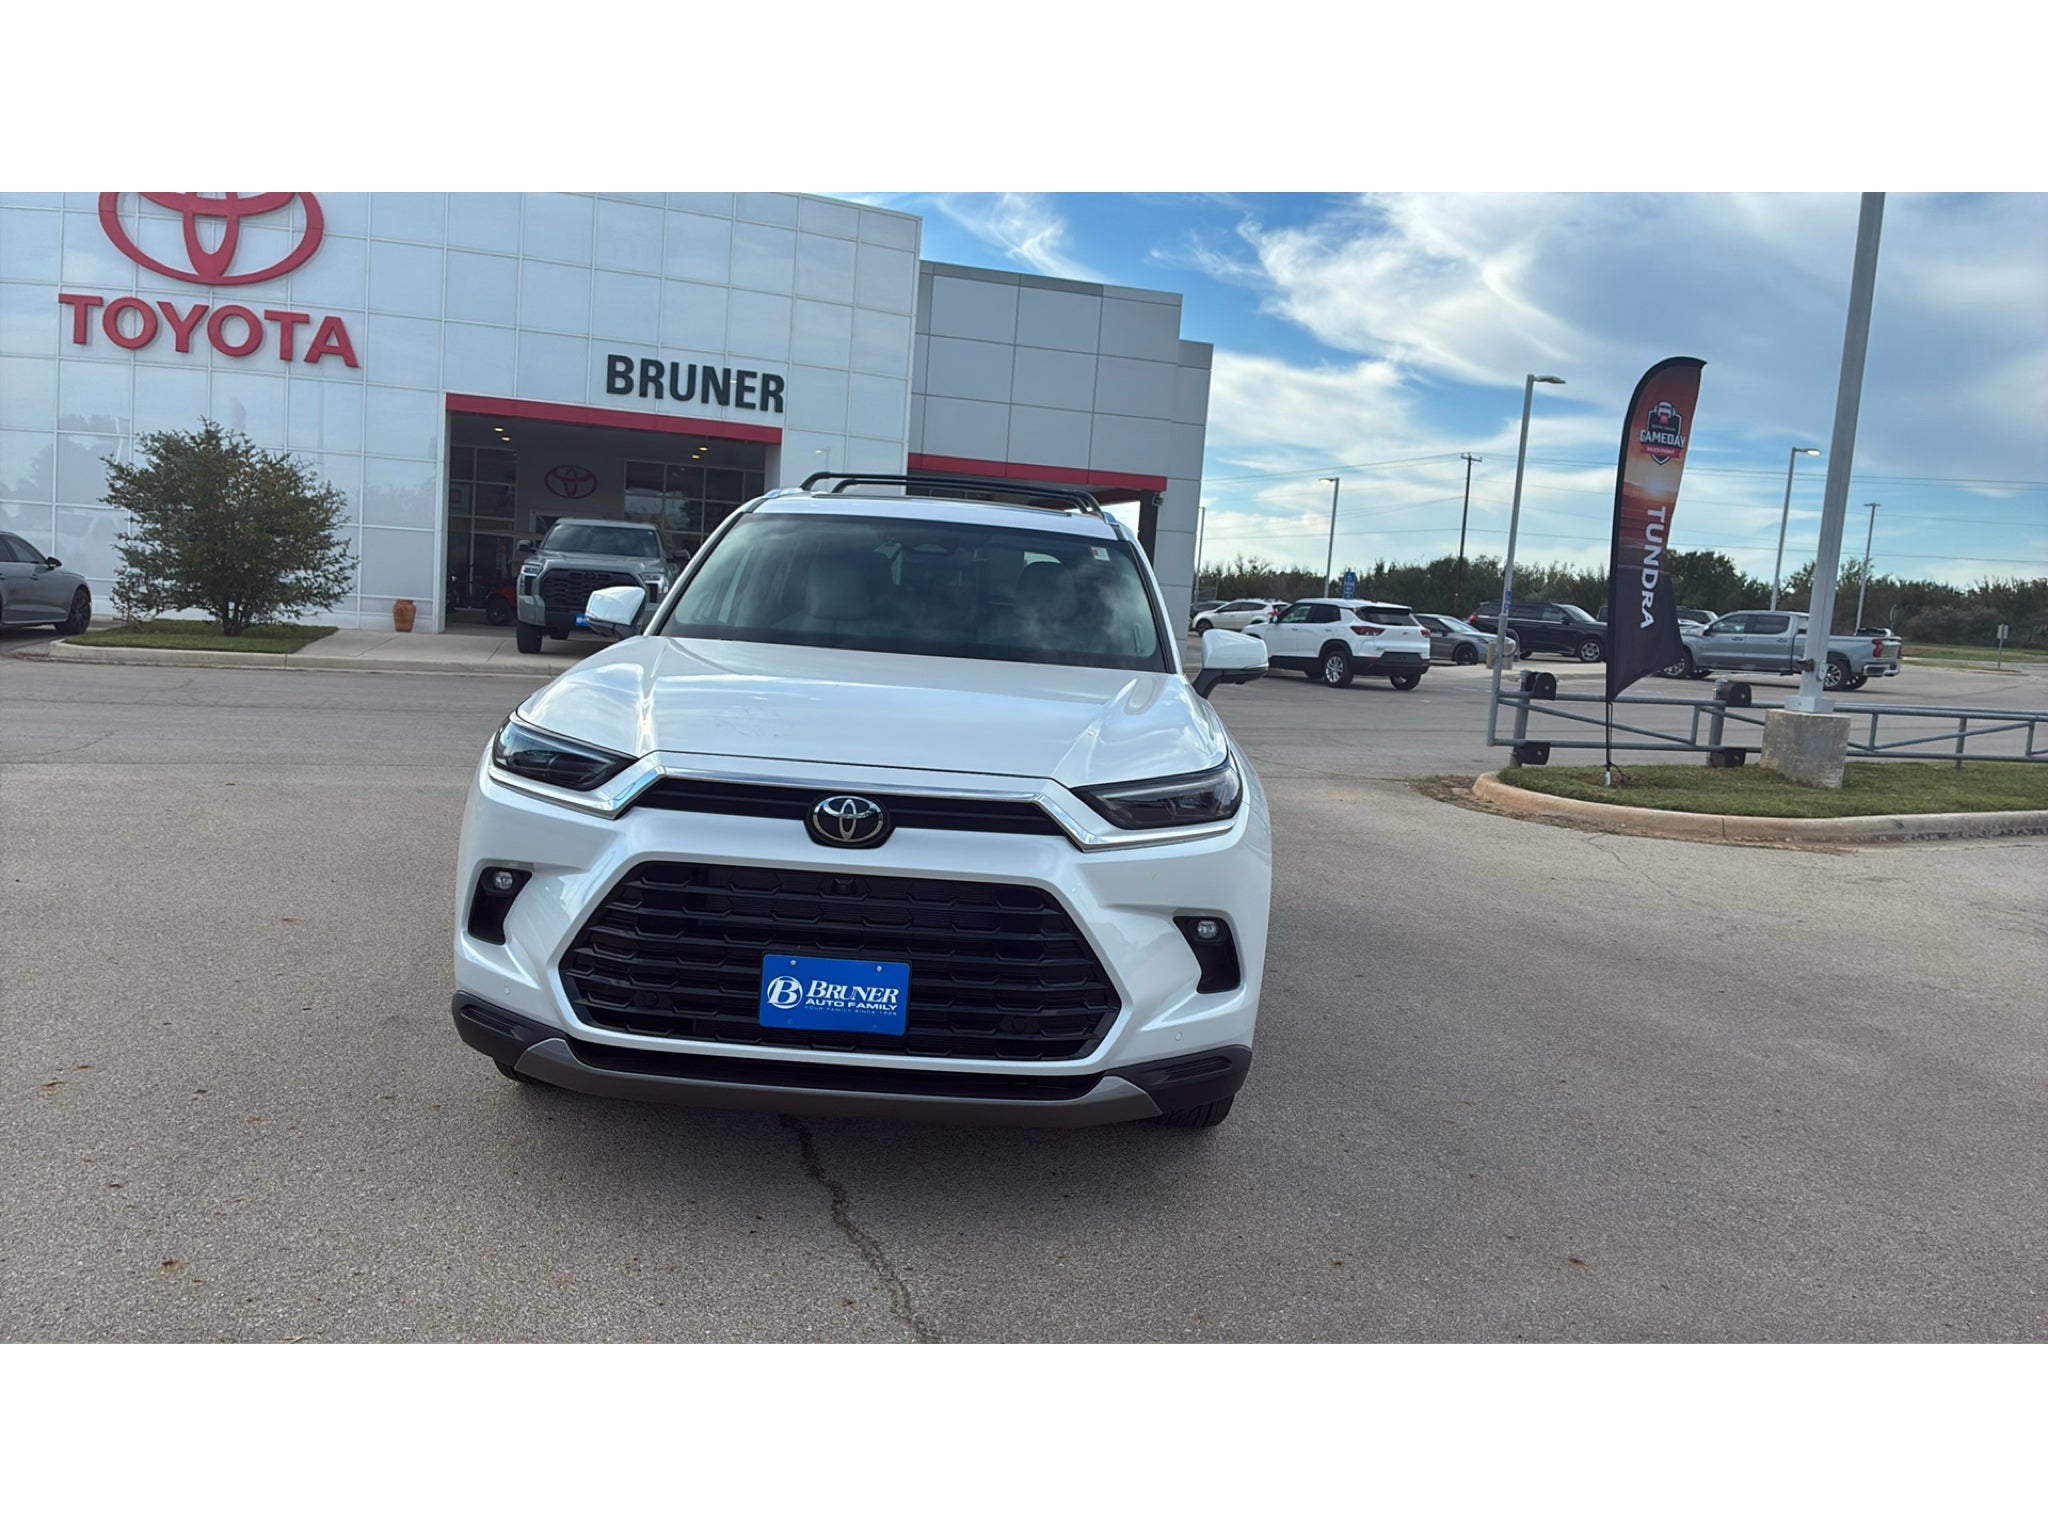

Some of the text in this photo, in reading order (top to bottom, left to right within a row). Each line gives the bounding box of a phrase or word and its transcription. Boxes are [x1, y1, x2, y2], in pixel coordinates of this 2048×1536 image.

[58, 293, 359, 368] TOYOTA
[607, 354, 785, 413] BRUNER
[1640, 429, 1686, 448] GAMEDAY
[1640, 506, 1666, 629] TUNDRA
[805, 998, 898, 1011] AUTO FAMILY
[806, 980, 900, 1003] BRUNER
